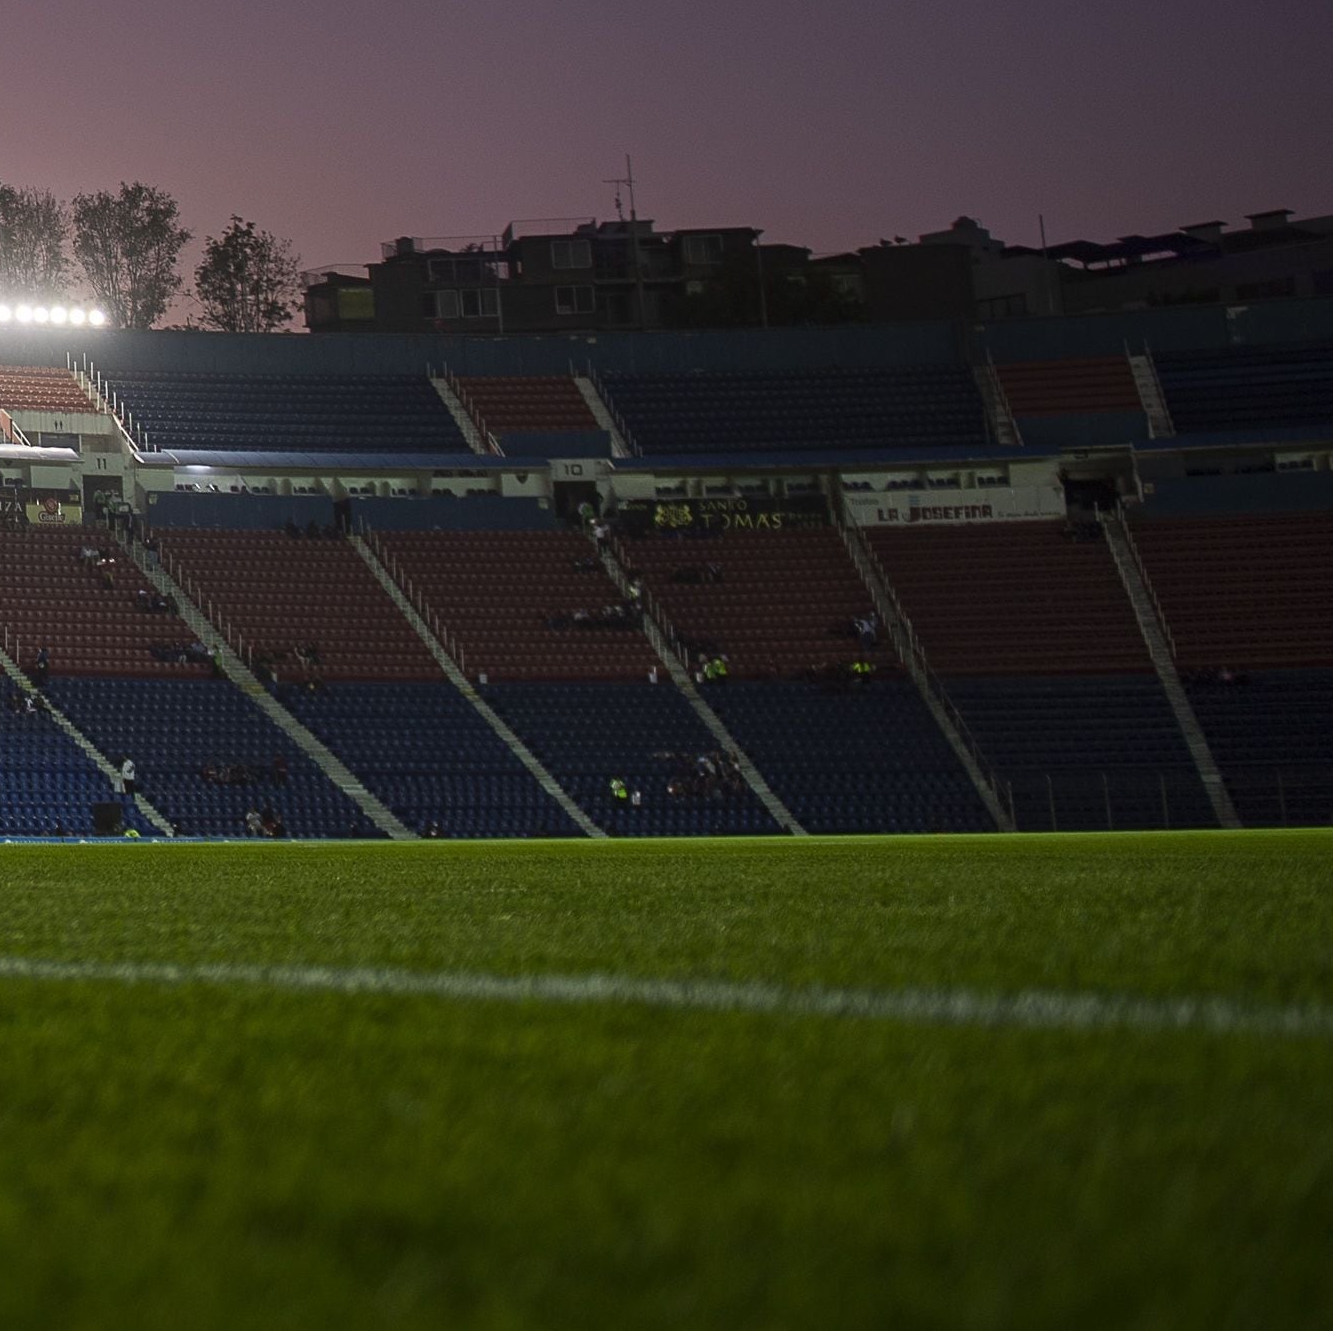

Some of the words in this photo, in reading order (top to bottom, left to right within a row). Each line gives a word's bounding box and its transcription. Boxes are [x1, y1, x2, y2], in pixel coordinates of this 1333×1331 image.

[96, 458, 107, 469] 11
[564, 464, 583, 476] 10
[878, 508, 899, 522] LA
[902, 501, 993, 522] JOSEFINA
